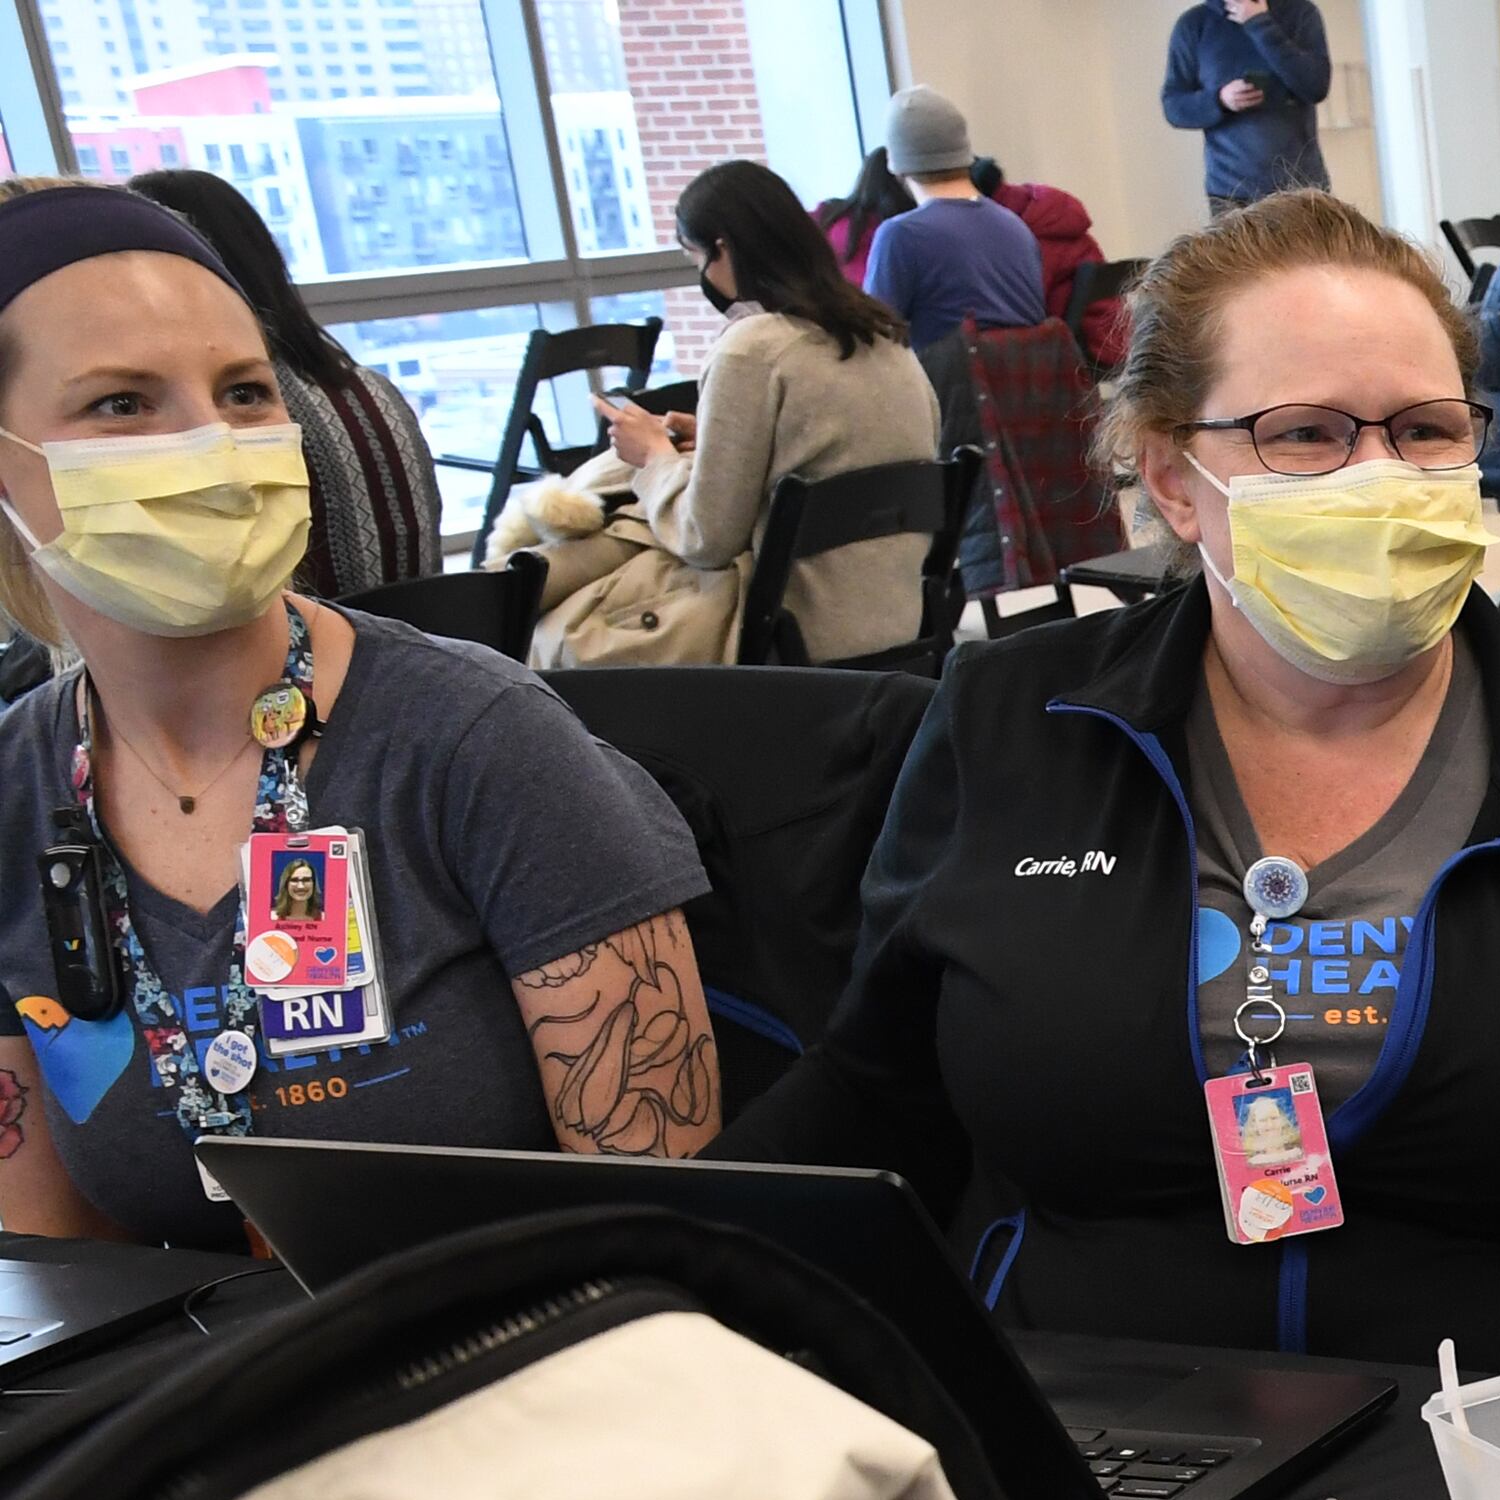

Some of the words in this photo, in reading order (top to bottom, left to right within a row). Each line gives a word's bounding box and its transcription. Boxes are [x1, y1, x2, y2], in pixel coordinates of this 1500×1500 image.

[1014, 855, 1078, 878] Carrie,
[1080, 850, 1117, 875] RN
[283, 993, 344, 1031] RN
[1324, 1004, 1389, 1025] est.
[213, 1042, 229, 1057] the
[231, 1053, 253, 1070] shot
[231, 1040, 248, 1054] got
[276, 1076, 348, 1108] 1860
[1264, 1166, 1291, 1177] Carrie
[1281, 1175, 1303, 1187] urse
[1304, 1173, 1318, 1182] RN
